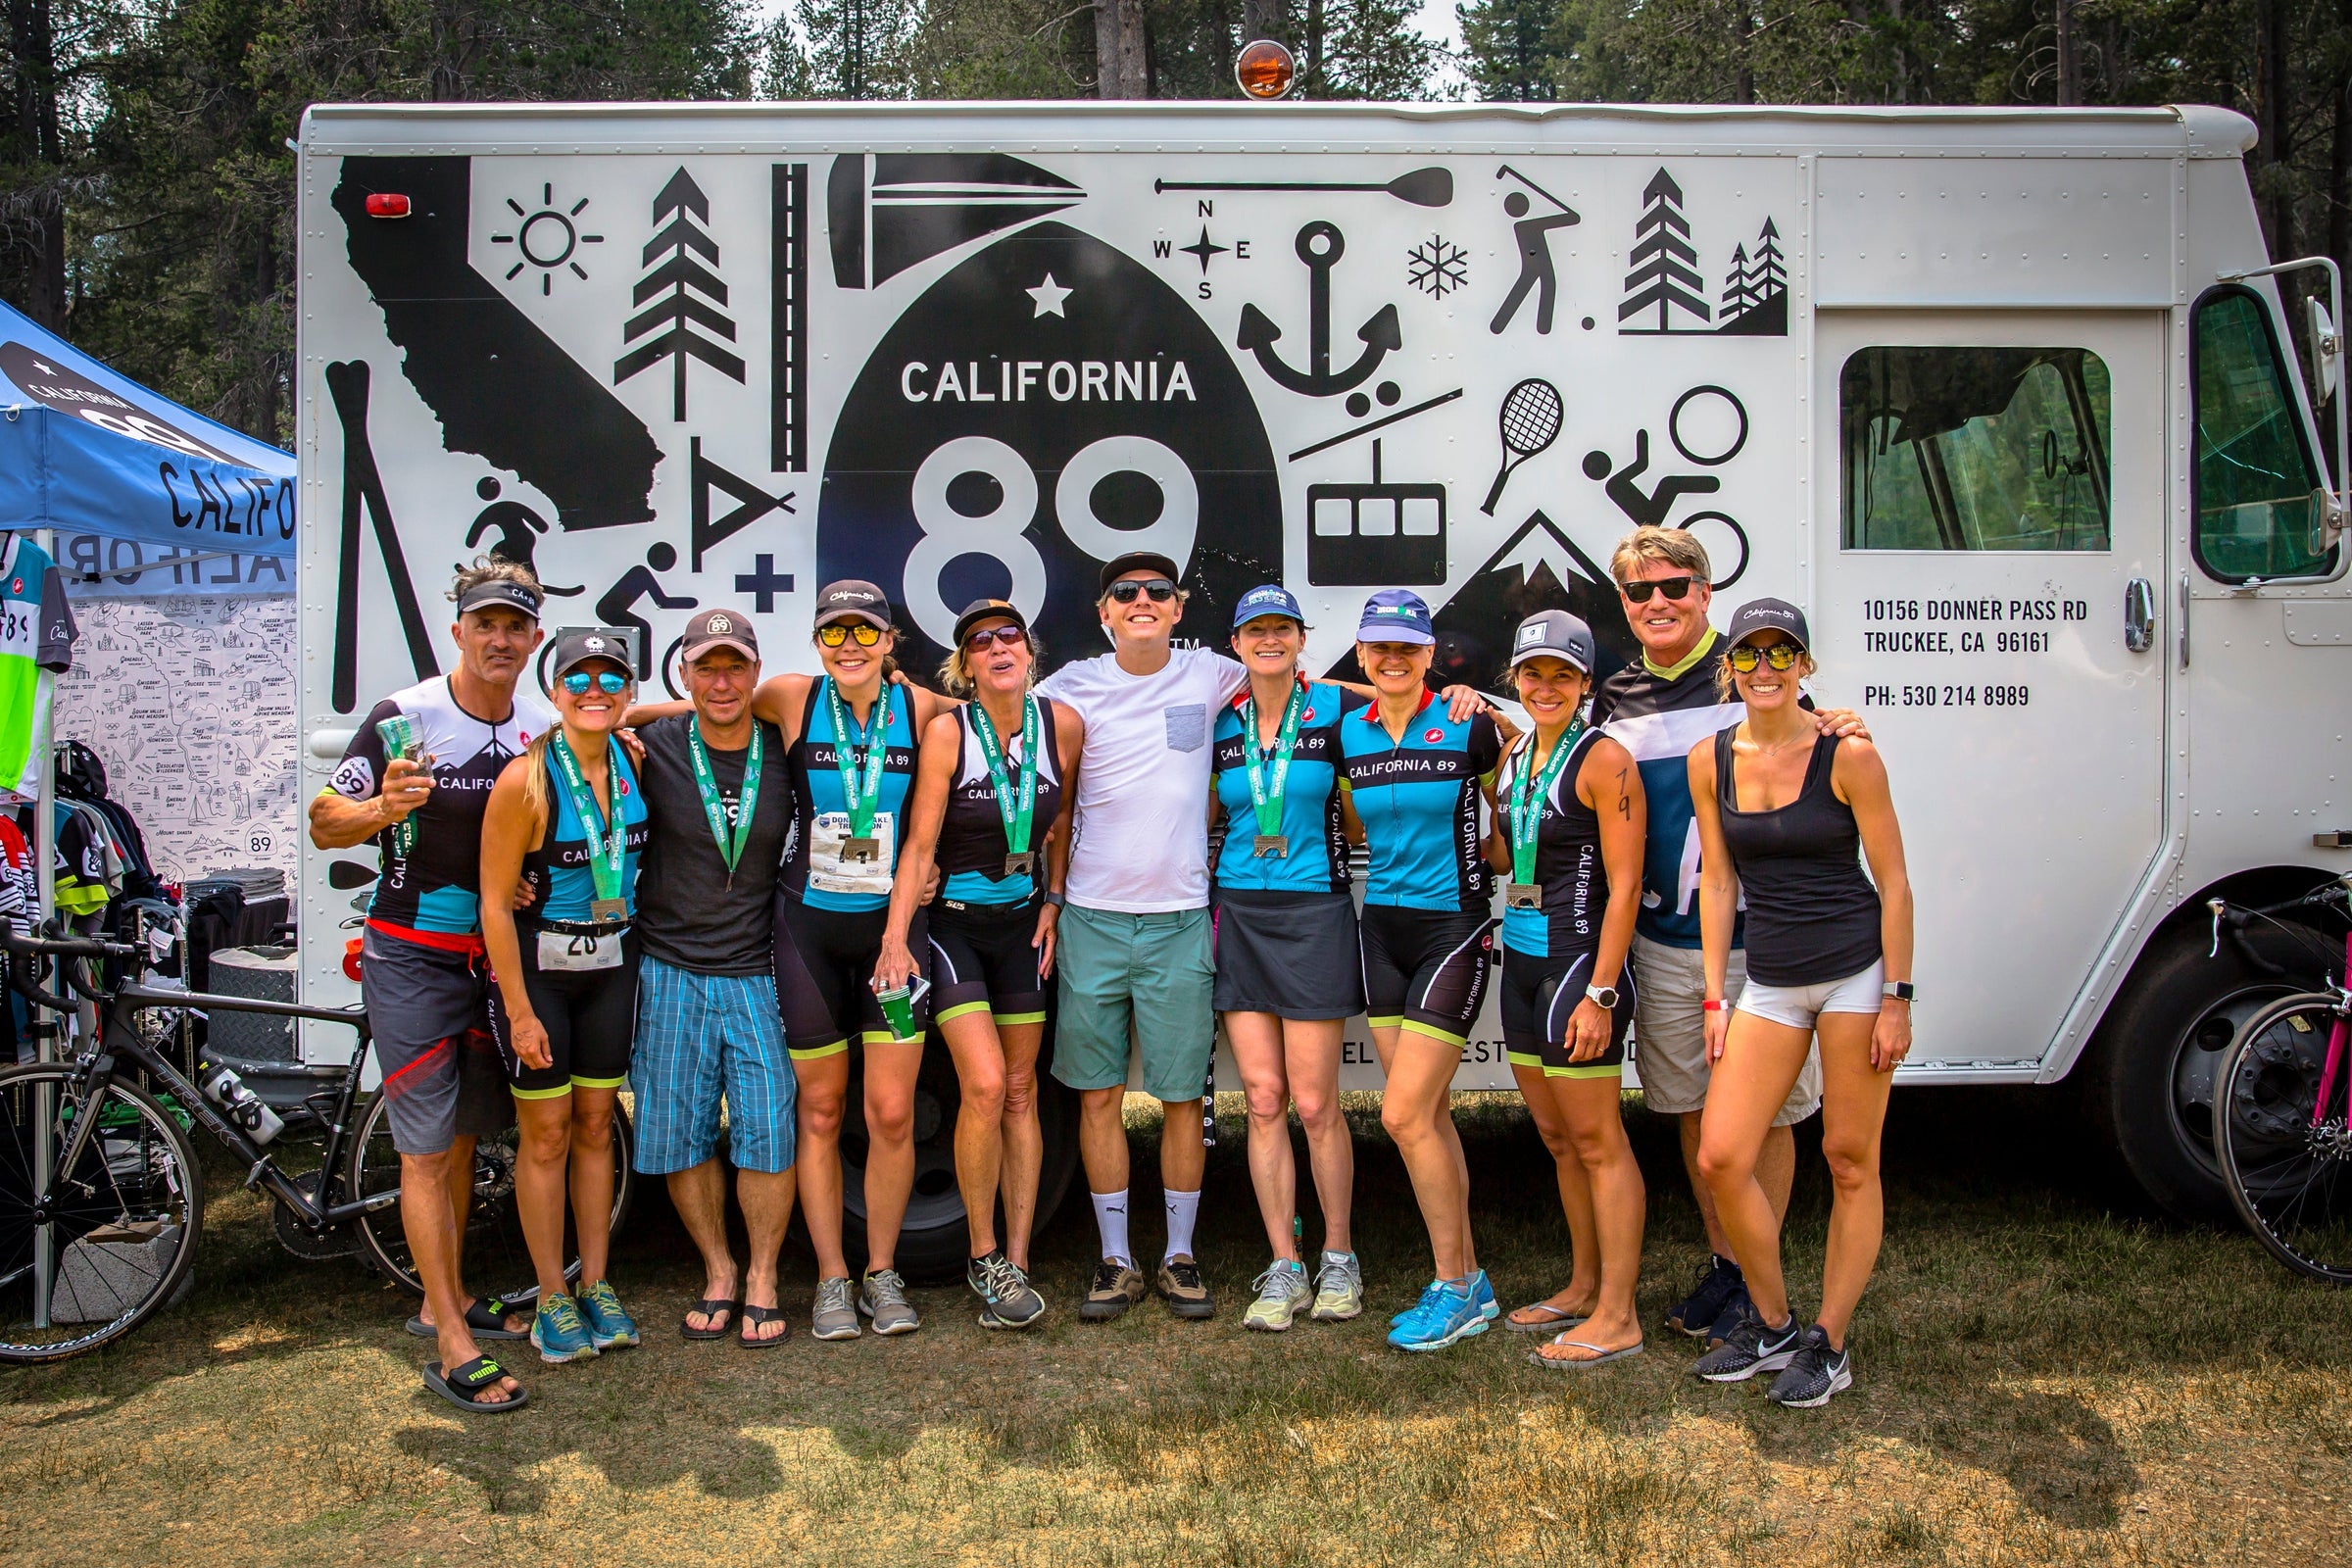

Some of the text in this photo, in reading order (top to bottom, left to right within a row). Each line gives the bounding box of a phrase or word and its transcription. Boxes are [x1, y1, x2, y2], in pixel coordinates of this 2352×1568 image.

[1198, 199, 1213, 218] N
[1152, 240, 1250, 260] W E
[1198, 281, 1212, 300] S
[901, 361, 1198, 403] CALIFORNIA
[27, 383, 135, 412] CALIFORNIA
[902, 435, 1200, 652] 89
[1863, 600, 2087, 620] 10156 DONNER PASS RD
[711, 620, 728, 632] 89
[1864, 632, 2050, 656] TRUCKEE, CA 96161
[1865, 686, 2030, 706] PH: 530 214 8989
[829, 689, 847, 742] AQUABIKE
[1286, 698, 1299, 734] SPRINT
[976, 709, 998, 758] AQUABIKE
[1308, 738, 1326, 750] 89
[690, 739, 707, 777] SPRINT
[896, 755, 909, 765] 89
[1547, 737, 1571, 774] SPRINT
[559, 749, 579, 788] SPRINT
[1348, 759, 1457, 780] CALIFORNIA 89
[335, 768, 366, 795] 89
[1037, 783, 1050, 795] 89
[250, 836, 271, 853] 89
[1468, 872, 1481, 891] 89
[1573, 844, 1594, 935] CALIFORNIA 89
[567, 935, 598, 956] 20
[156, 1063, 241, 1148] TREK
[59, 1097, 90, 1159] TREK
